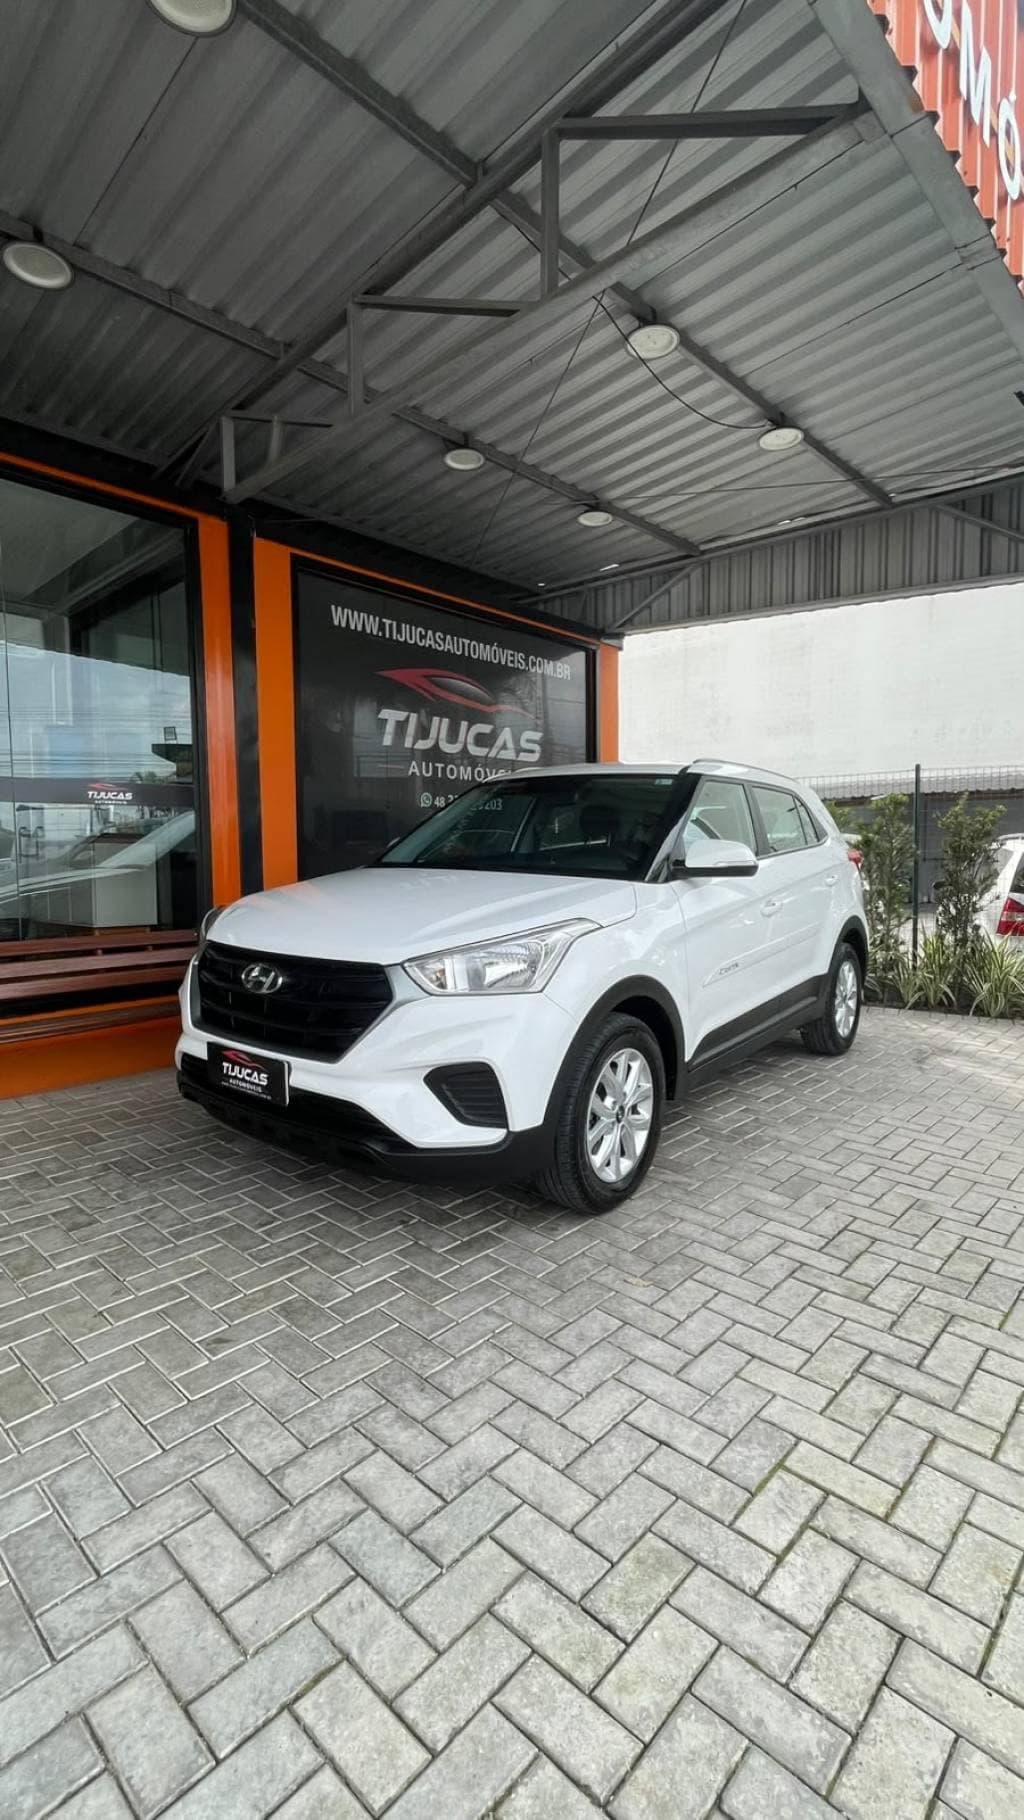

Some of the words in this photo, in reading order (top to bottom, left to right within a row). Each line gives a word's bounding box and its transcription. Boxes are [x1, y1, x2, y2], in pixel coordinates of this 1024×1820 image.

[330, 604, 571, 680] WWW.TIJUCASAUTOMÓVEIS.COM.BR
[378, 708, 543, 763] TIJUCAS
[408, 760, 513, 782] AUTOMÓV
[87, 791, 133, 800] TIJUCAS
[433, 796, 446, 809] 48
[222, 1061, 268, 1086] TIJUCAS
